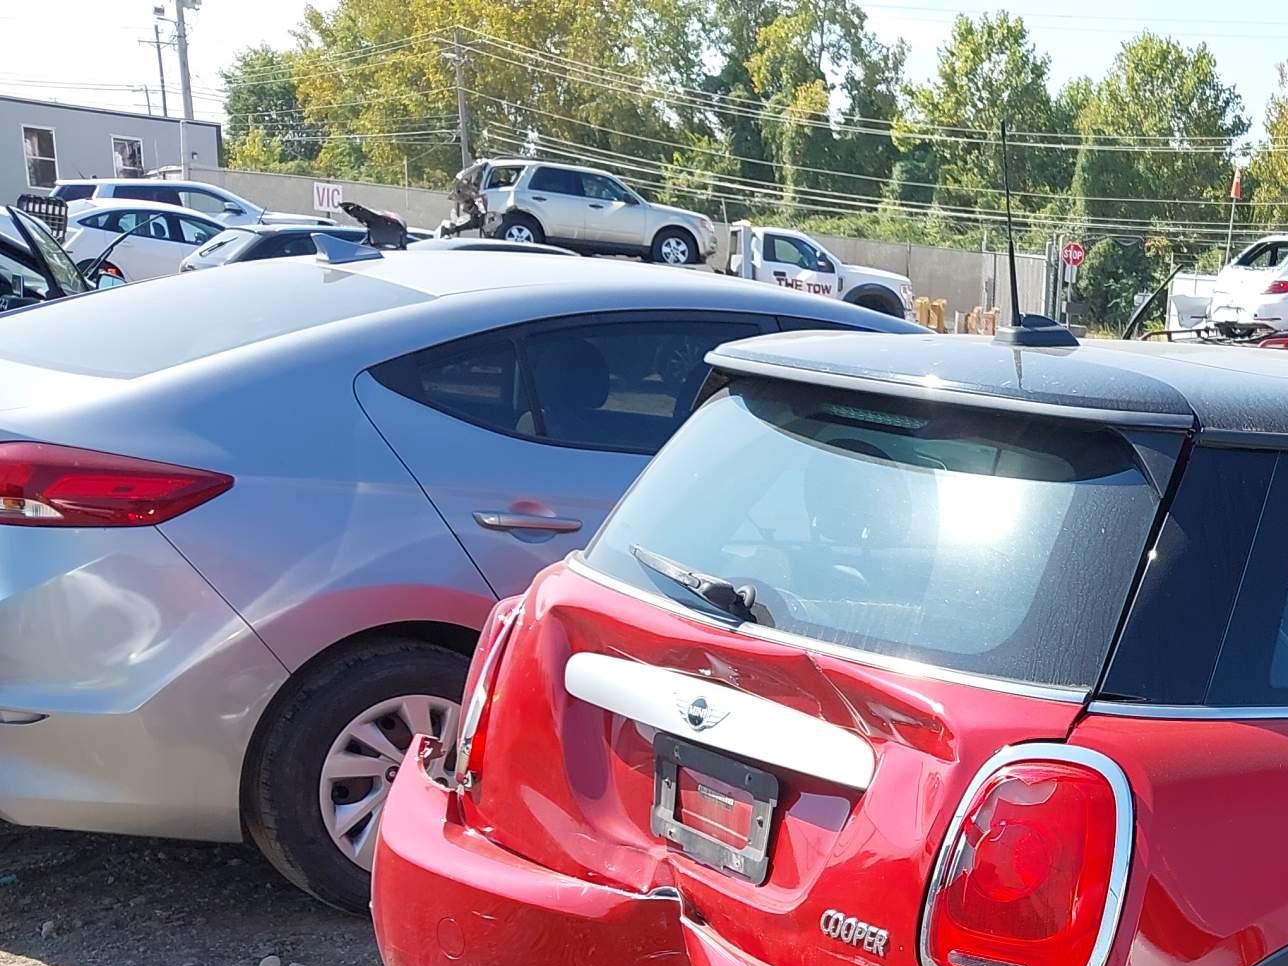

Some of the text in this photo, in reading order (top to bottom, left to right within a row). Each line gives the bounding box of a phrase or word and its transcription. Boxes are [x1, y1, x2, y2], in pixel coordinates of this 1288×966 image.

[315, 186, 341, 209] VIC
[1063, 248, 1083, 260] STOP
[775, 277, 832, 295] THE TOW
[820, 909, 888, 957] COOPER
